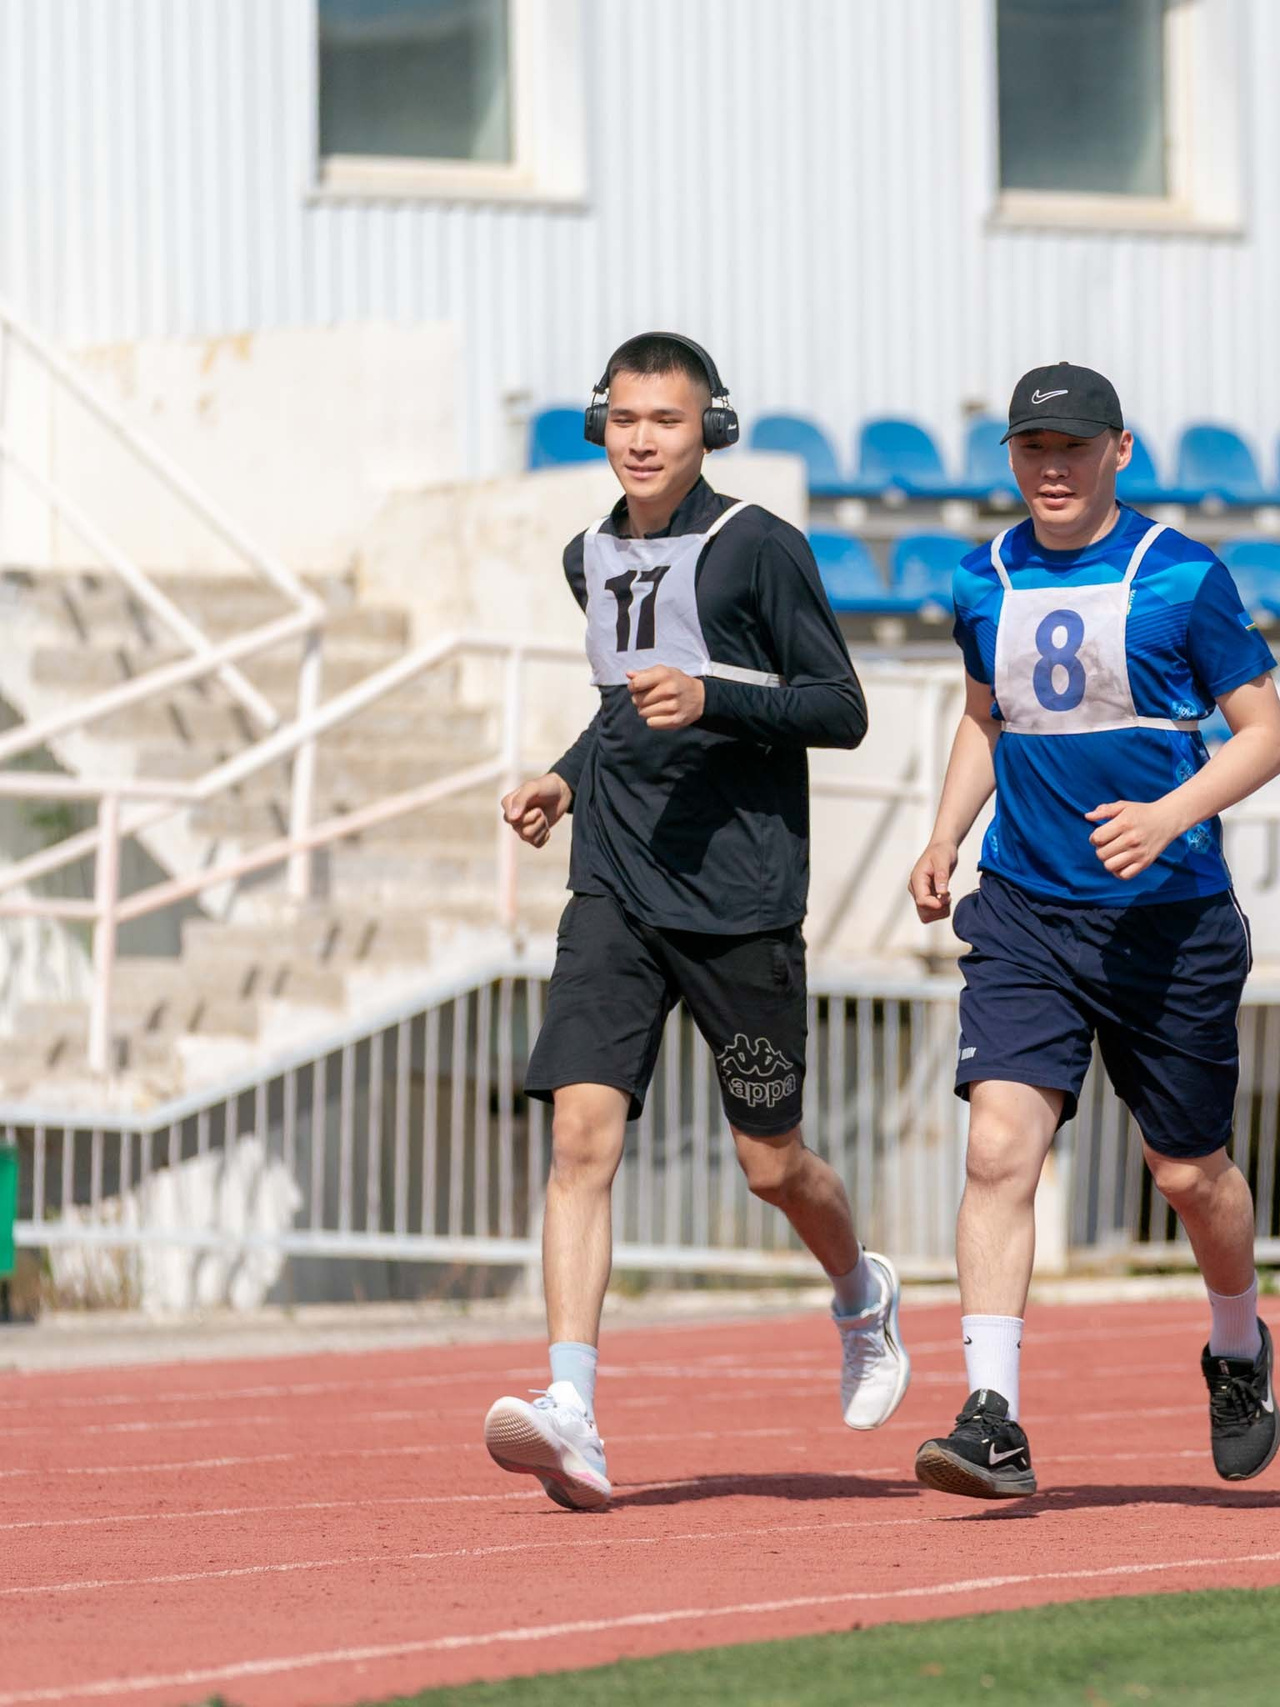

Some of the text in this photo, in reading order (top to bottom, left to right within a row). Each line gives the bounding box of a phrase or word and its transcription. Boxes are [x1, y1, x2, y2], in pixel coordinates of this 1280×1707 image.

[604, 565, 671, 653] 17
[1032, 608, 1086, 712] 8
[721, 1070, 797, 1108] appa
